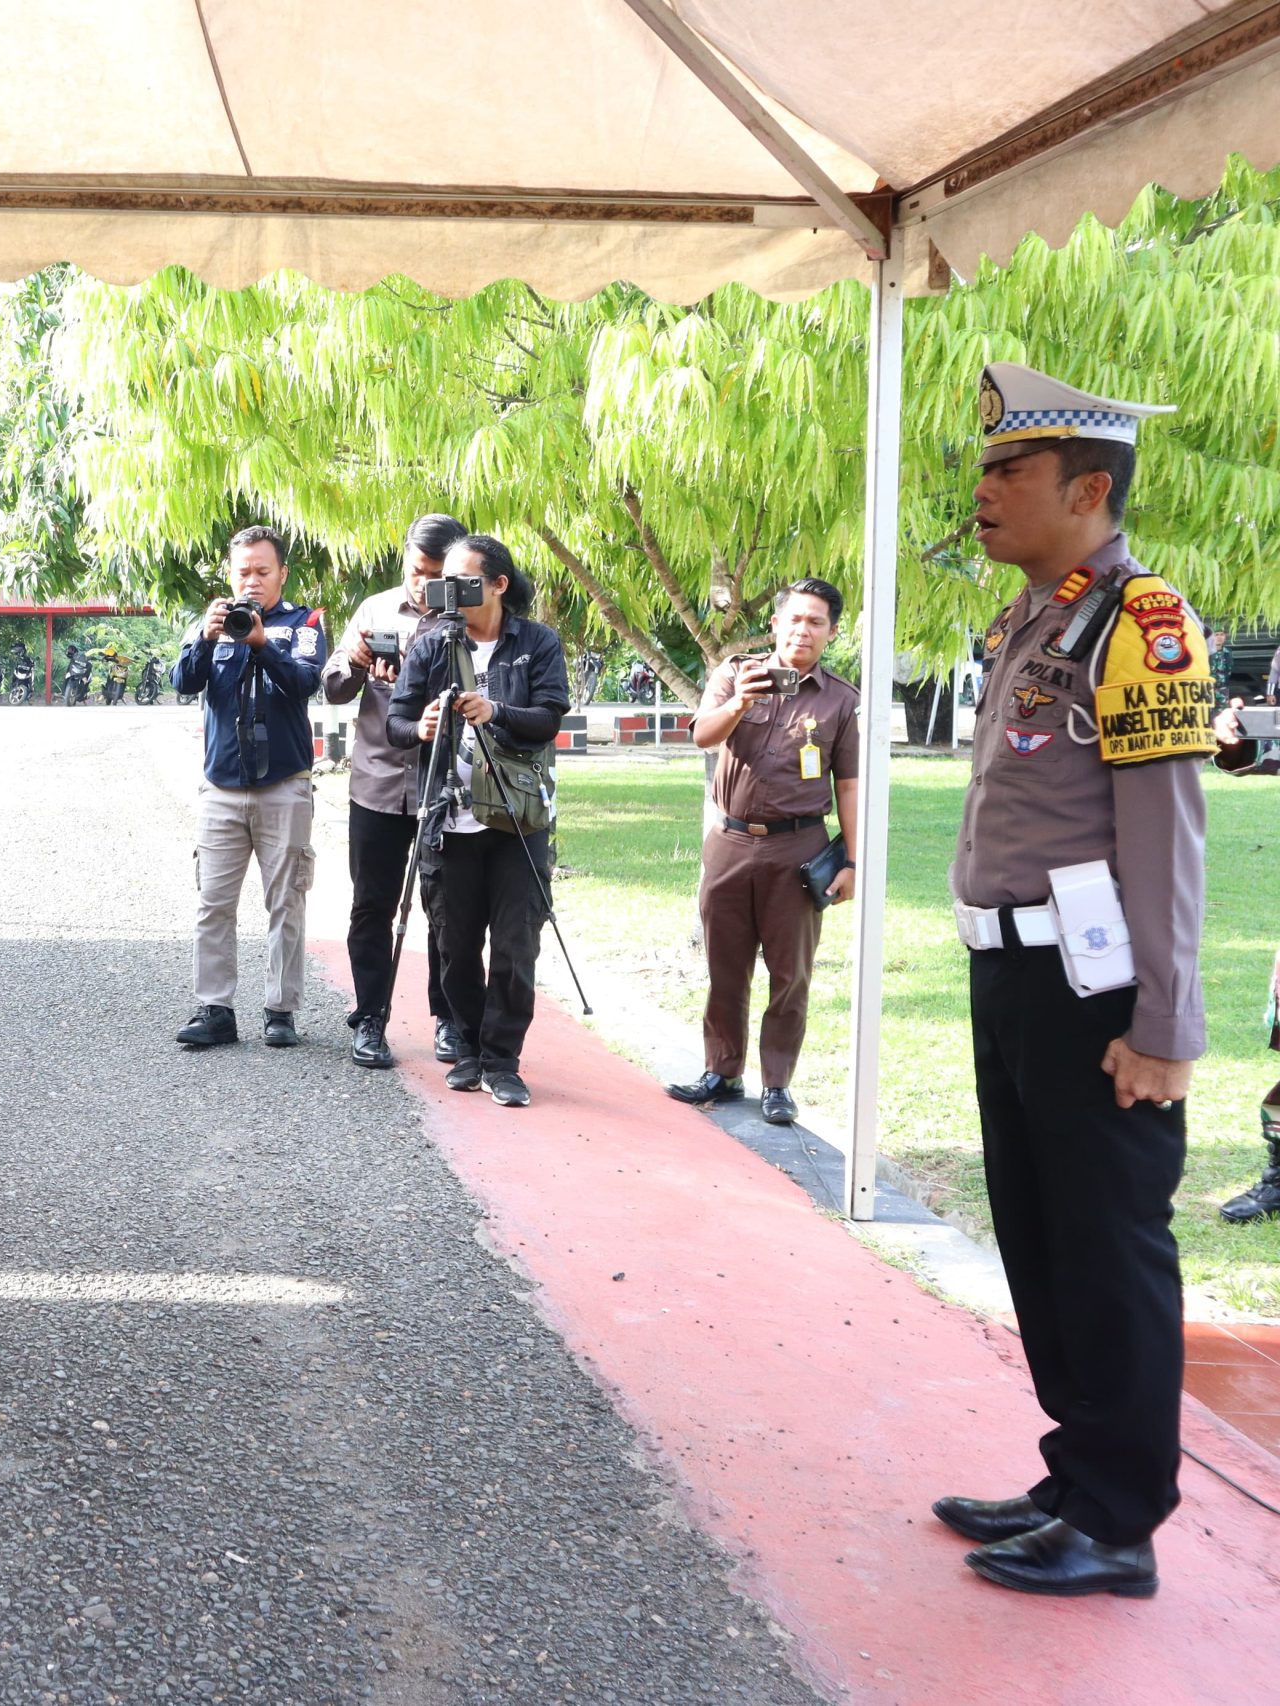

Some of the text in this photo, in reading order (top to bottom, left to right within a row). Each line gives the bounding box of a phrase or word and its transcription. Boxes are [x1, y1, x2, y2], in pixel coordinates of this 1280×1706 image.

[1019, 659, 1074, 690] POLRI
[1123, 680, 1214, 710] KA SATGAS
[1109, 739, 1125, 754] OPS
[1127, 733, 1166, 752] MANTAP
[1171, 731, 1202, 746] BRATA
